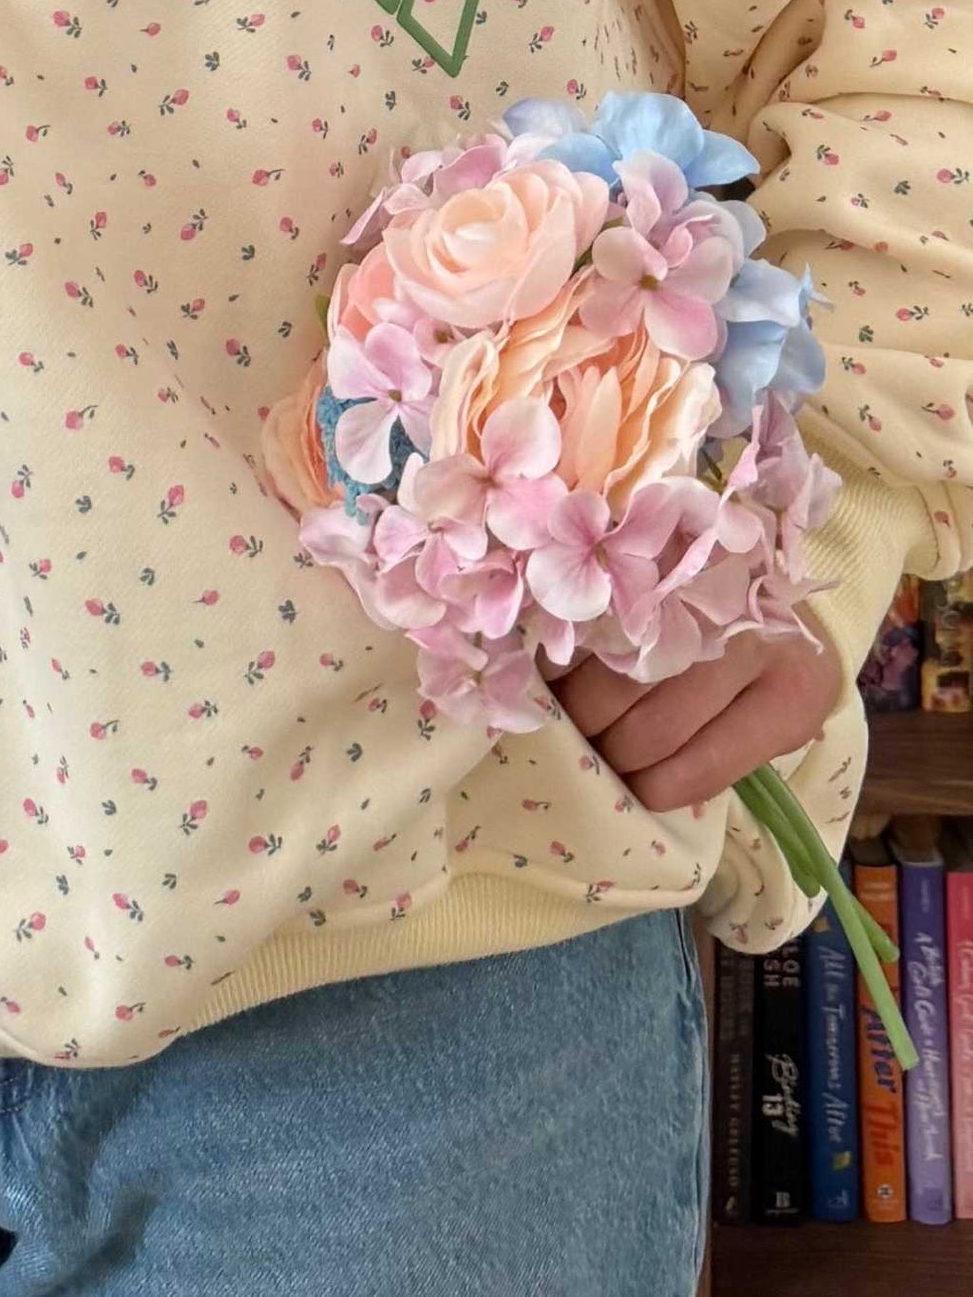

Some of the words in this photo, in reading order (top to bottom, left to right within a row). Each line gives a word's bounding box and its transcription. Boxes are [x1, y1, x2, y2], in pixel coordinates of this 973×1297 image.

[781, 941, 800, 989] LOE
[762, 1093, 782, 1117] 13
[868, 1104, 899, 1167] This
